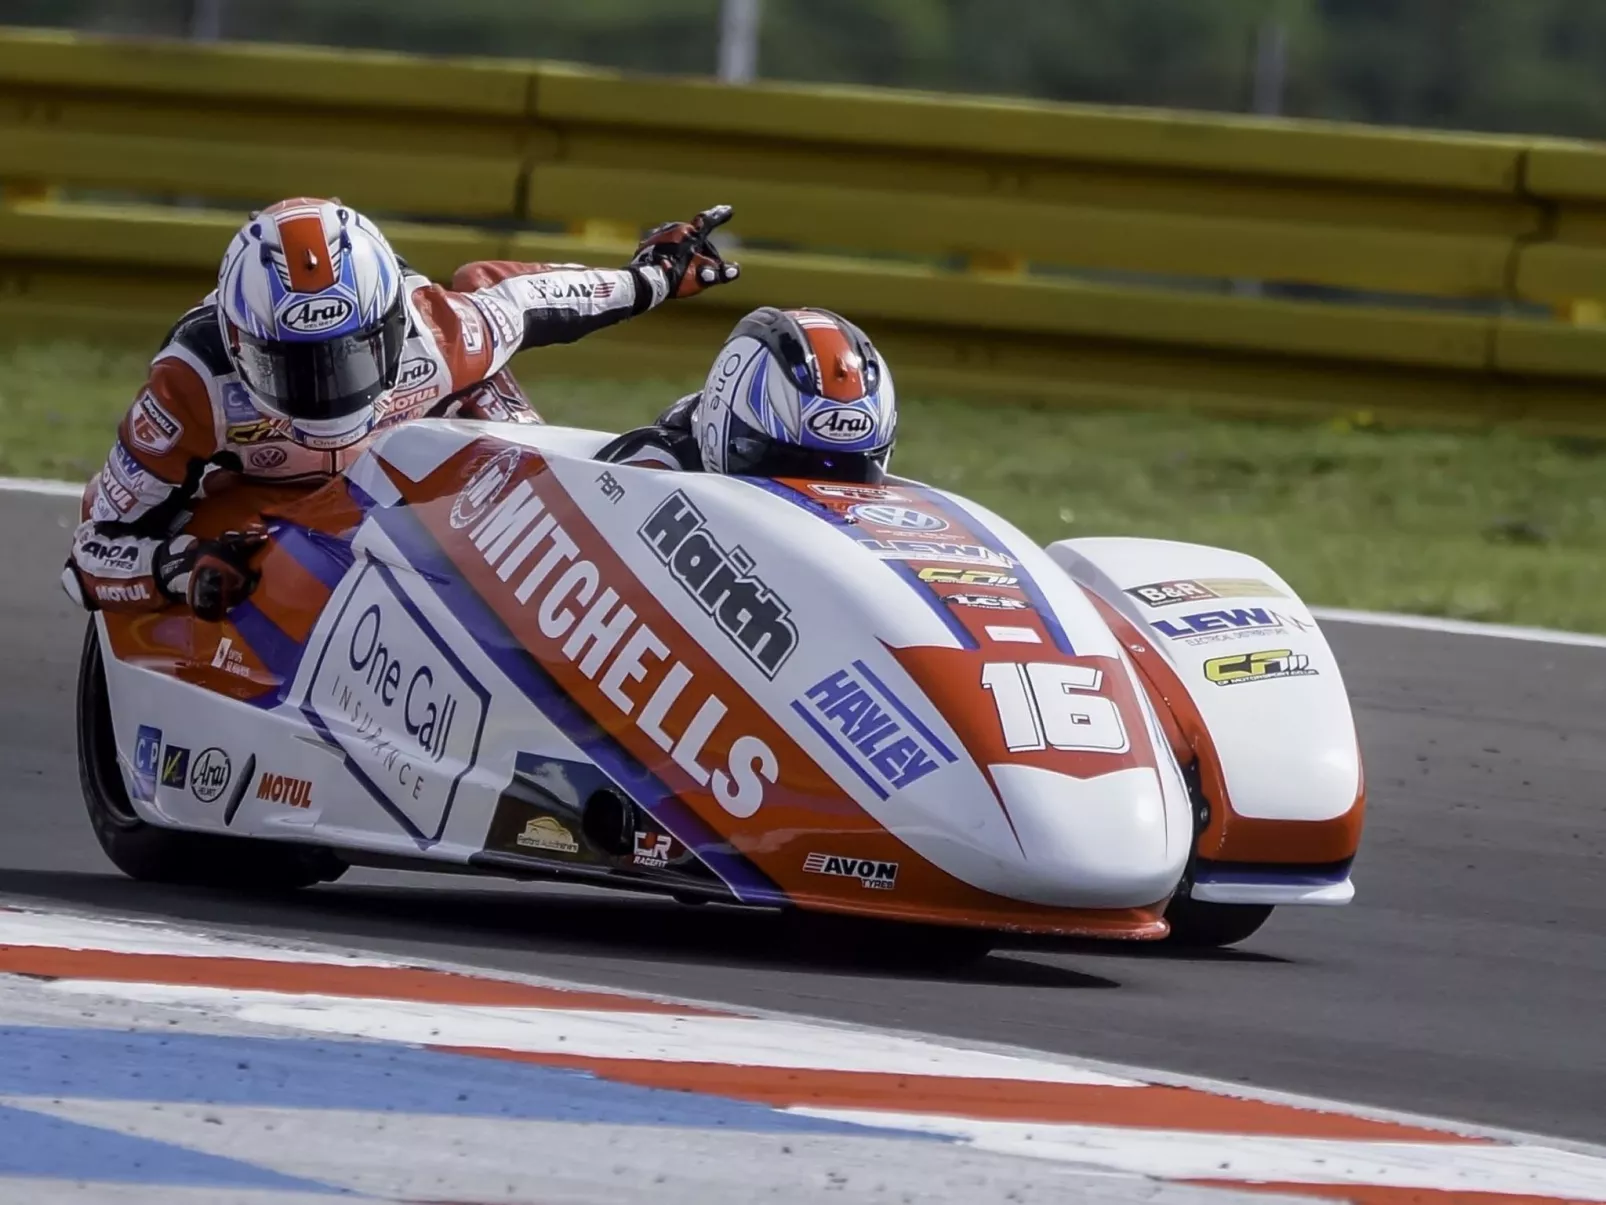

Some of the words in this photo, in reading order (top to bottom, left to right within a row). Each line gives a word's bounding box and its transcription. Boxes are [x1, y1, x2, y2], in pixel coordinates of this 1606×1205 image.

[287, 299, 346, 326] Arai
[398, 360, 431, 384] rai
[710, 353, 741, 411] One
[812, 411, 869, 432] Arai
[102, 467, 133, 509] OTUL
[95, 583, 150, 602] MOTUL
[637, 487, 799, 682] Haith
[1137, 582, 1205, 601] B&R
[1150, 608, 1274, 637] LEW
[468, 479, 778, 818] MITCHELLS
[349, 604, 401, 707] One
[404, 665, 457, 763] Call
[981, 662, 1130, 754] 16
[331, 675, 425, 801] INSURANCE
[804, 669, 940, 790] HAYLEY
[192, 753, 230, 786] Arai
[256, 772, 312, 809] MOTUL
[824, 857, 898, 879] AVON
[862, 879, 893, 889] TYRES
